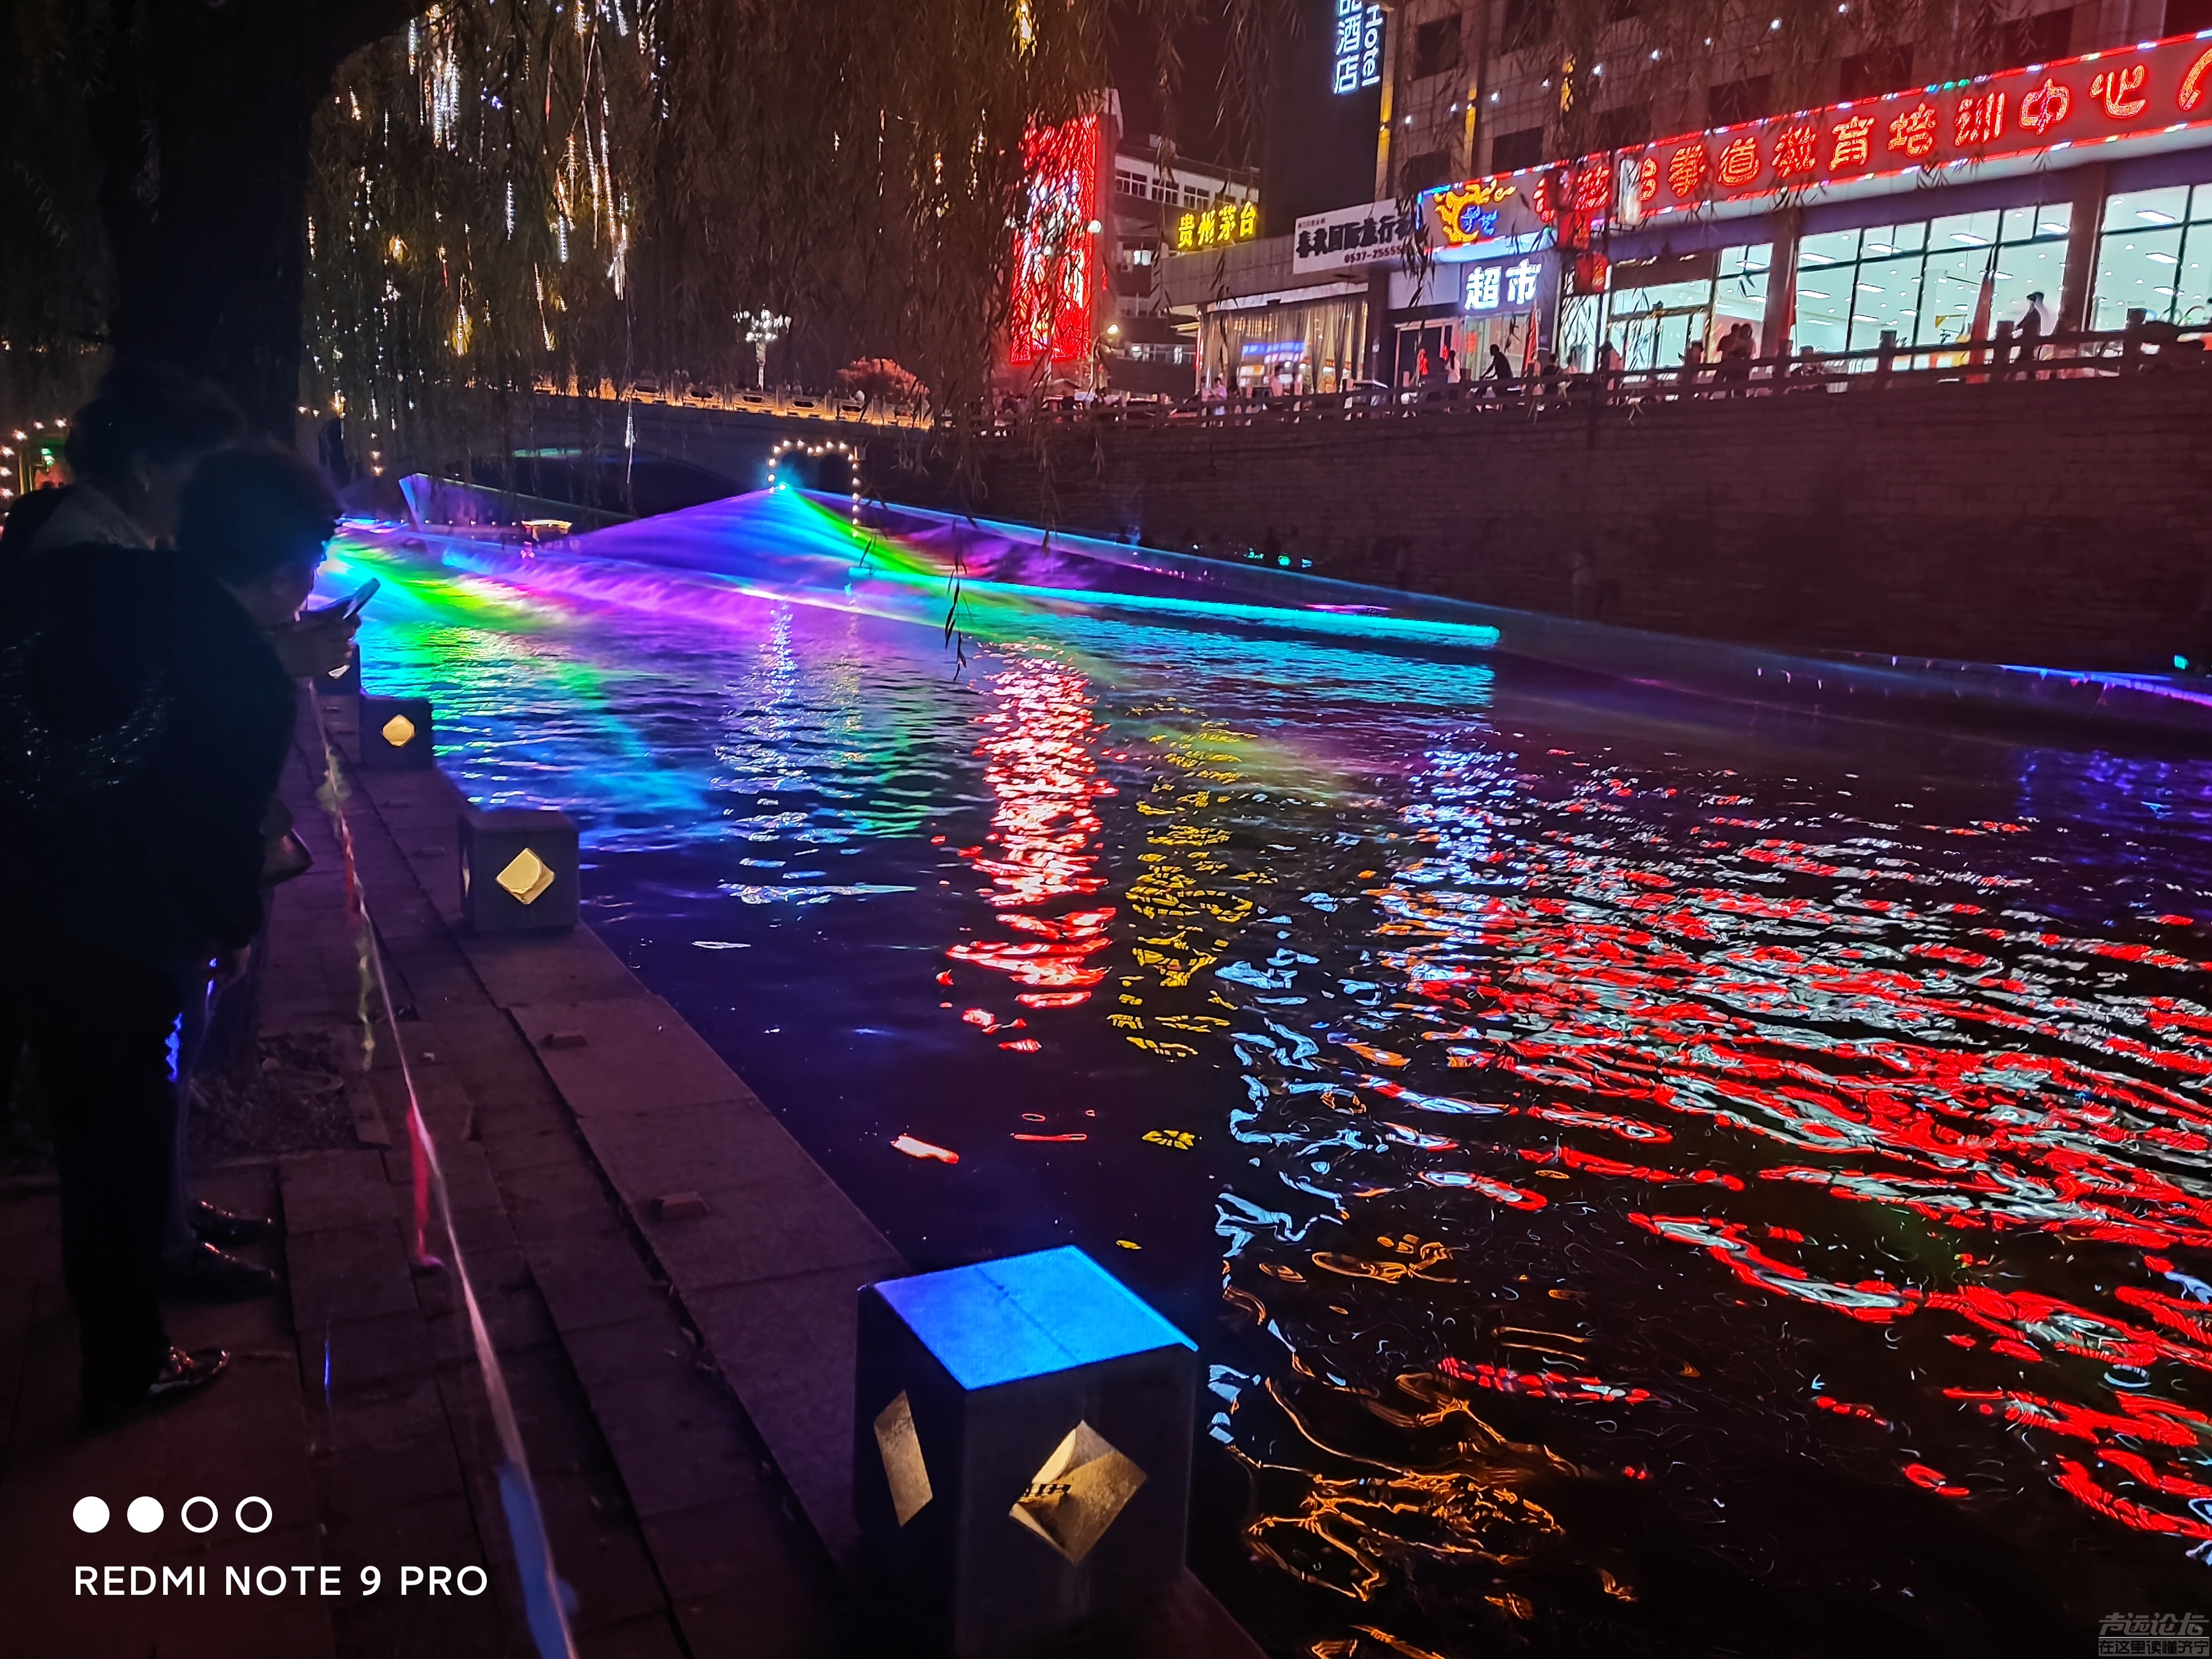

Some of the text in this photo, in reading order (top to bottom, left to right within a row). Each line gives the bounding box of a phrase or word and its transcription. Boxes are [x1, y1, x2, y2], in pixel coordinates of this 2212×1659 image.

[1361, 4, 1383, 87] Hotel
[1178, 201, 1256, 248] 贵州茅台
[1464, 258, 1541, 310] 超市
